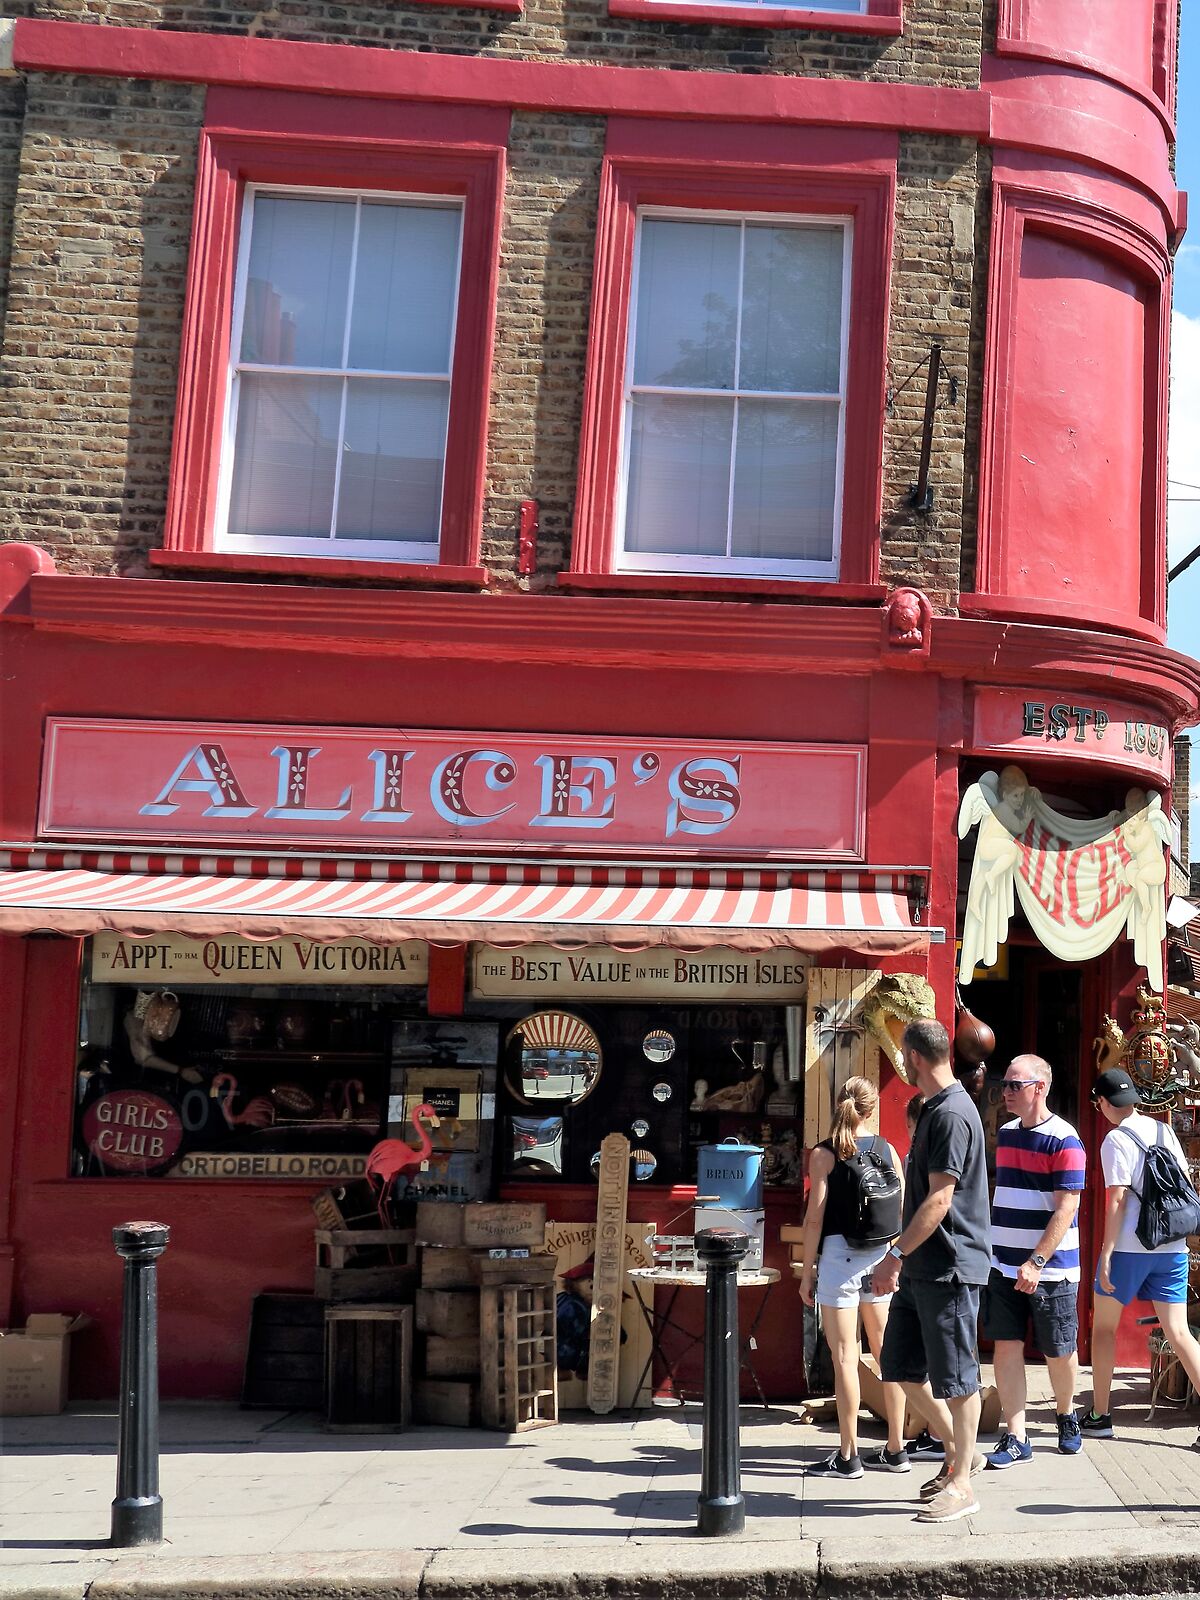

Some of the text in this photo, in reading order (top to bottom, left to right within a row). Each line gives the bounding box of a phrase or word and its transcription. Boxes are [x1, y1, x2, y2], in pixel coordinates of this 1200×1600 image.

[139, 743, 744, 836] ALICE'S
[202, 941, 283, 977] QUEEN
[293, 942, 407, 971] VICTORIA
[482, 955, 805, 985] THE BEST VALUE IN THE BRITISH ISLES
[96, 1100, 174, 1130] GIRLS'
[97, 1129, 164, 1158] CLUB
[177, 1156, 366, 1176] ORTOBELLO ROAD
[706, 1168, 744, 1180] BREAD
[404, 1184, 469, 1197] CHANEL
[601, 1142, 625, 1240] NOTTING
[598, 1242, 619, 1291] HILL
